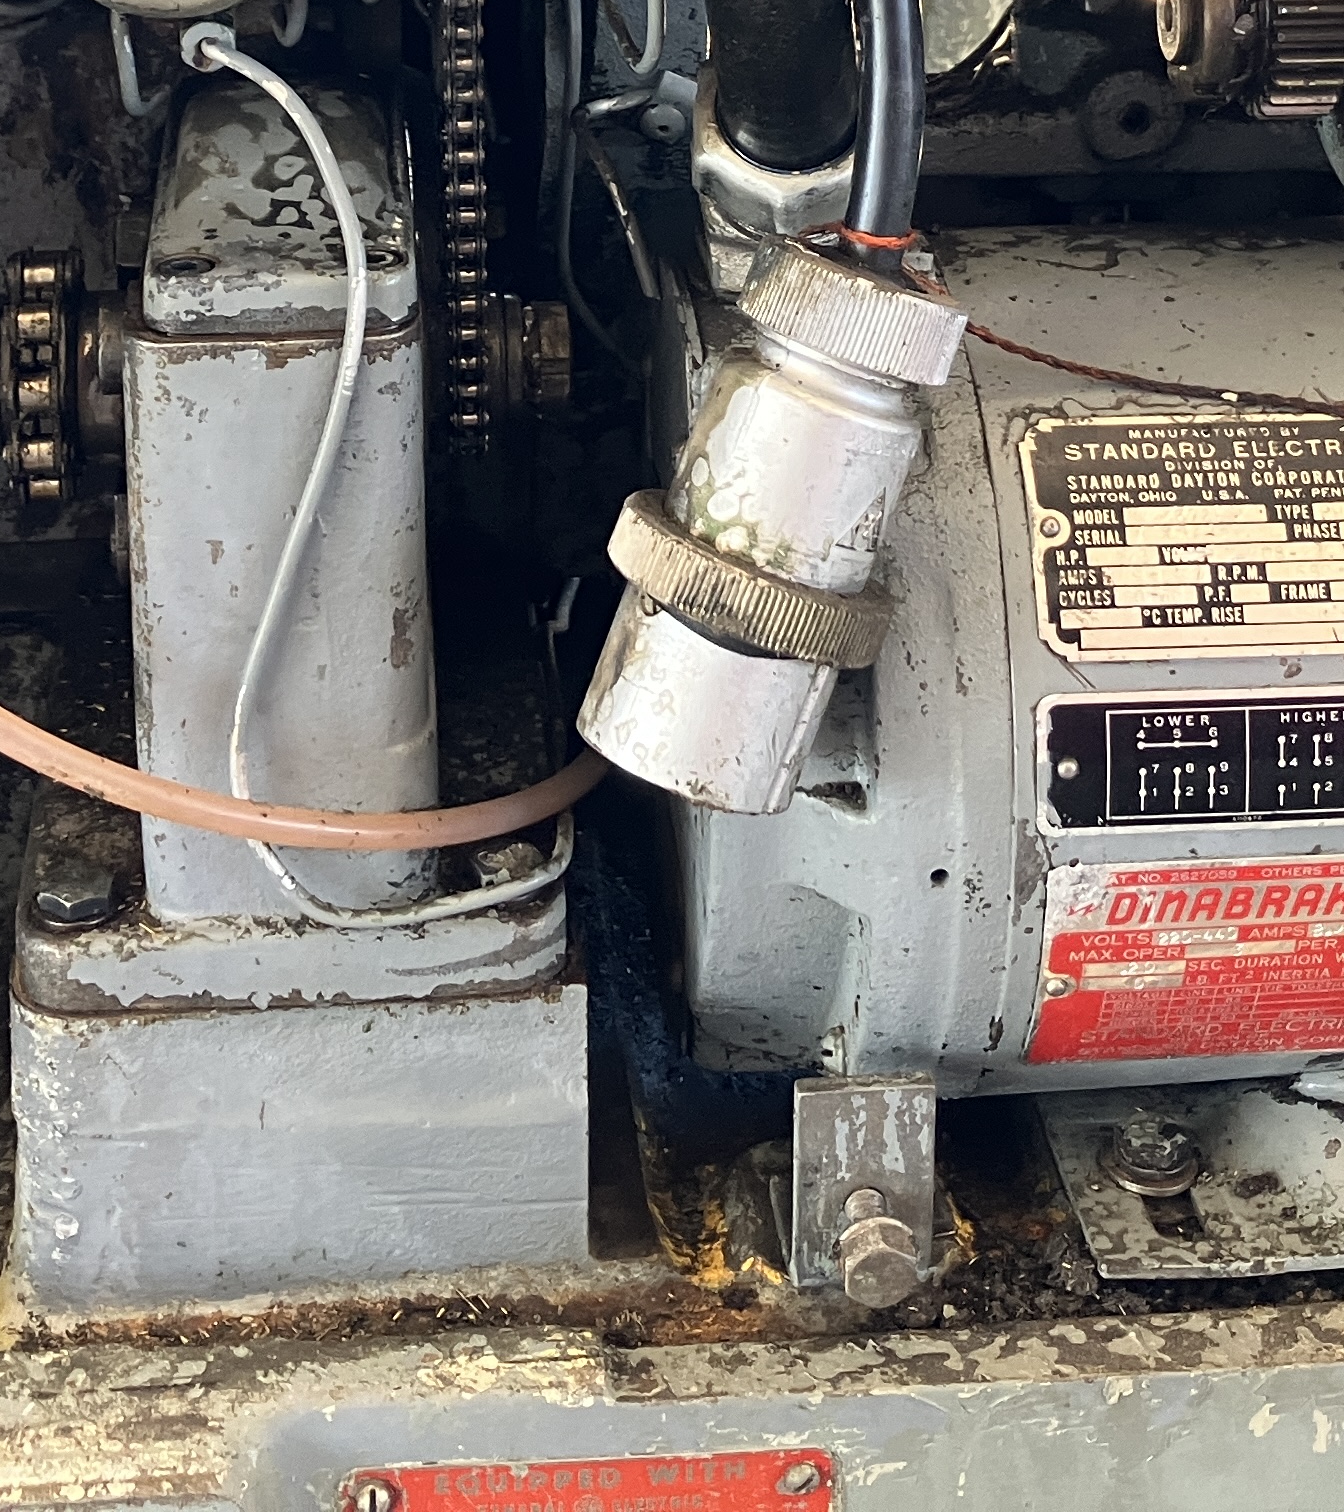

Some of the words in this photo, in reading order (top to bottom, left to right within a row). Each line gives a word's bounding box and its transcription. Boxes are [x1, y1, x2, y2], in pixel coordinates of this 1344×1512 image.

[1064, 441, 1216, 460] STANDARD
[1164, 459, 1246, 471] DIVISION
[1067, 472, 1160, 490] STANDARD
[1171, 471, 1241, 488] DAYTON
[1069, 491, 1134, 504] DAYTON,
[1138, 490, 1177, 502] OHIO
[1073, 509, 1119, 525] MODEL
[1274, 504, 1310, 520] TYPE
[1075, 529, 1123, 545] SERIAL
[1293, 522, 1340, 538] PHASE
[1056, 550, 1084, 565] H.P.
[1162, 546, 1206, 563] VOS
[1058, 569, 1097, 585] AMPS
[1217, 565, 1263, 580] R.P.M.
[1059, 590, 1111, 606] CYCLES
[1204, 586, 1230, 602] P.F.
[1280, 583, 1328, 600] FRAME
[1165, 607, 1207, 624] TEMP.
[1211, 606, 1243, 623] RISE
[1142, 715, 1210, 728] LOWER
[1136, 729, 1146, 739] 4
[1208, 726, 1218, 737] 6
[1290, 734, 1298, 744] 7
[1289, 757, 1298, 767] 4
[1324, 755, 1333, 766] 5
[1152, 763, 1160, 774] 7
[1185, 786, 1194, 797] 2
[1219, 785, 1229, 796] 3
[1324, 781, 1333, 792] 2
[1261, 865, 1323, 878] OTHERS
[1081, 933, 1151, 947] VOLTS
[1248, 925, 1306, 939] AMPS
[1069, 949, 1117, 962] MAX.
[1187, 958, 1225, 971] SEC.
[1234, 953, 1323, 968] DURATION
[1262, 968, 1330, 981] INERTIA
[434, 1467, 622, 1496] EQUIPPED
[646, 1459, 746, 1487] WITH
